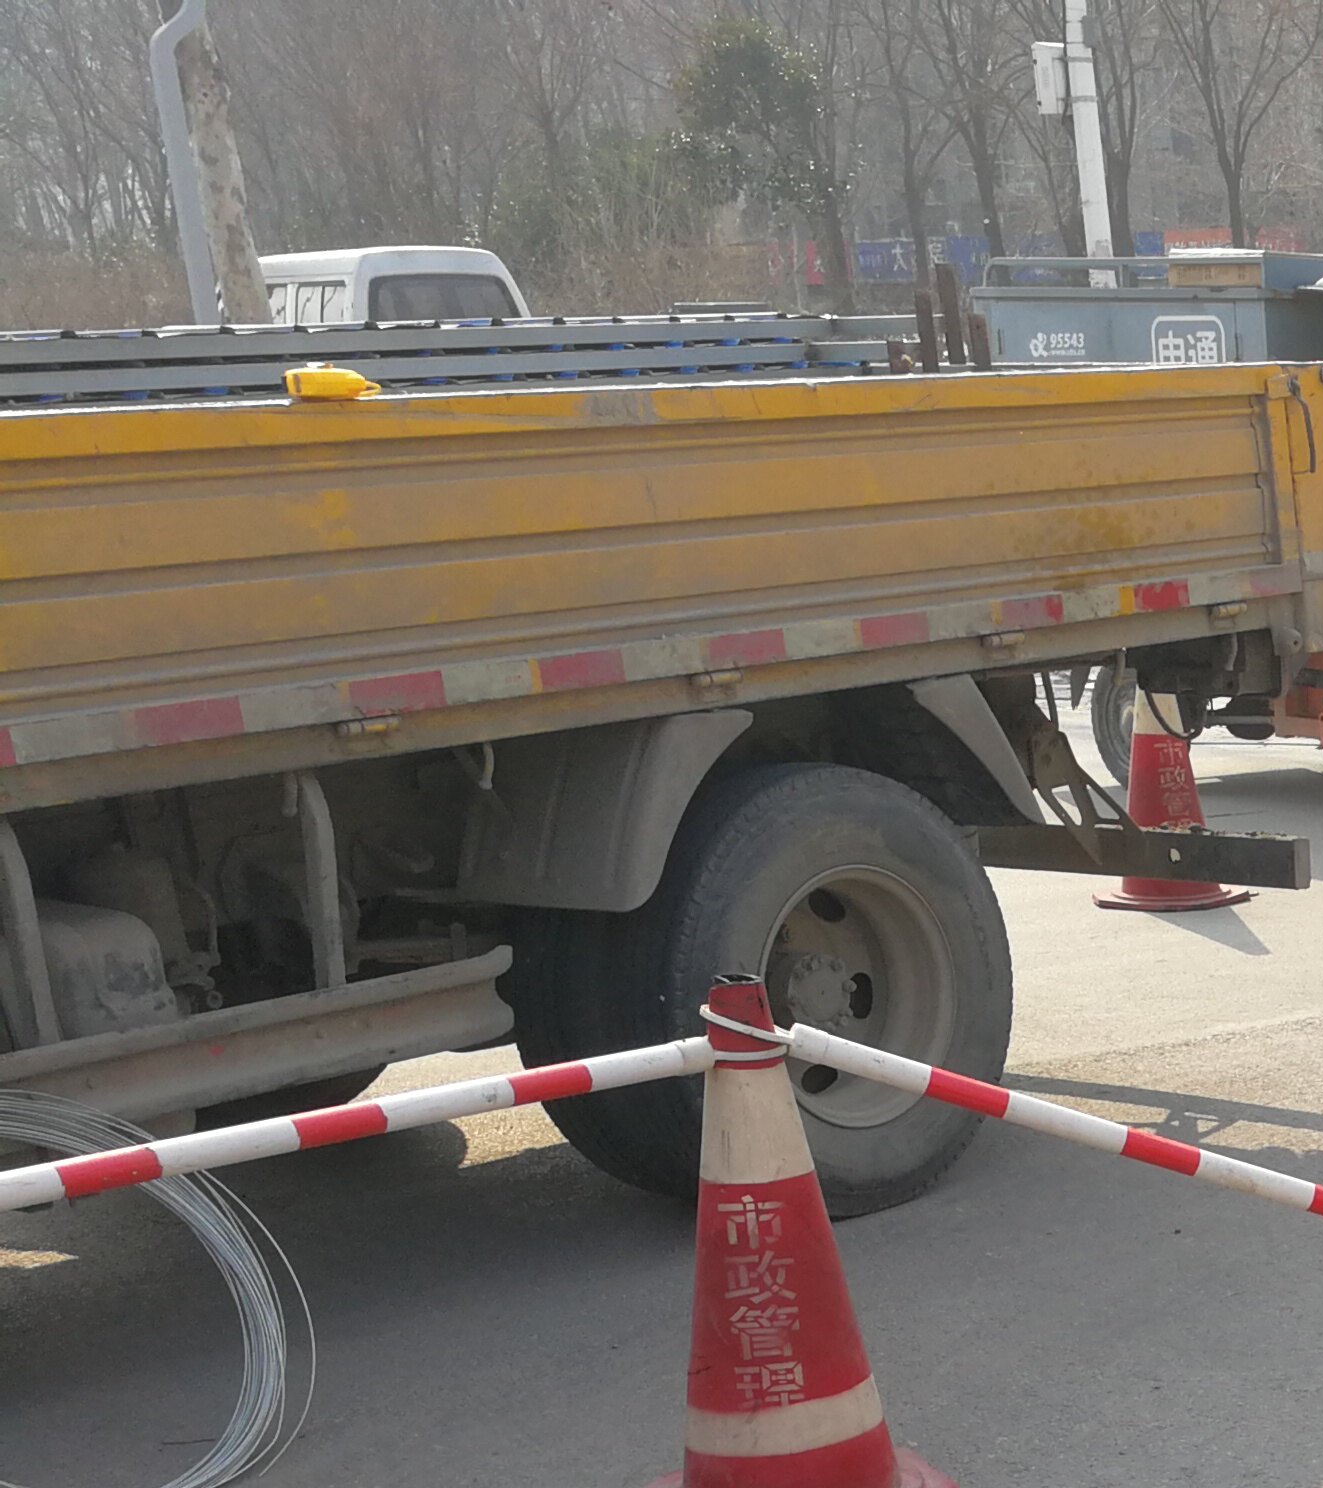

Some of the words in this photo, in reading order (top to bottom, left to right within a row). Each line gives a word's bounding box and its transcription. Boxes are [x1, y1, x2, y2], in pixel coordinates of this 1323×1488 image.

[1050, 333, 1085, 348] 95543
[1158, 330, 1218, 364] 申通
[1153, 740, 1194, 826] 市政管
[716, 1194, 805, 1406] 市政管理
